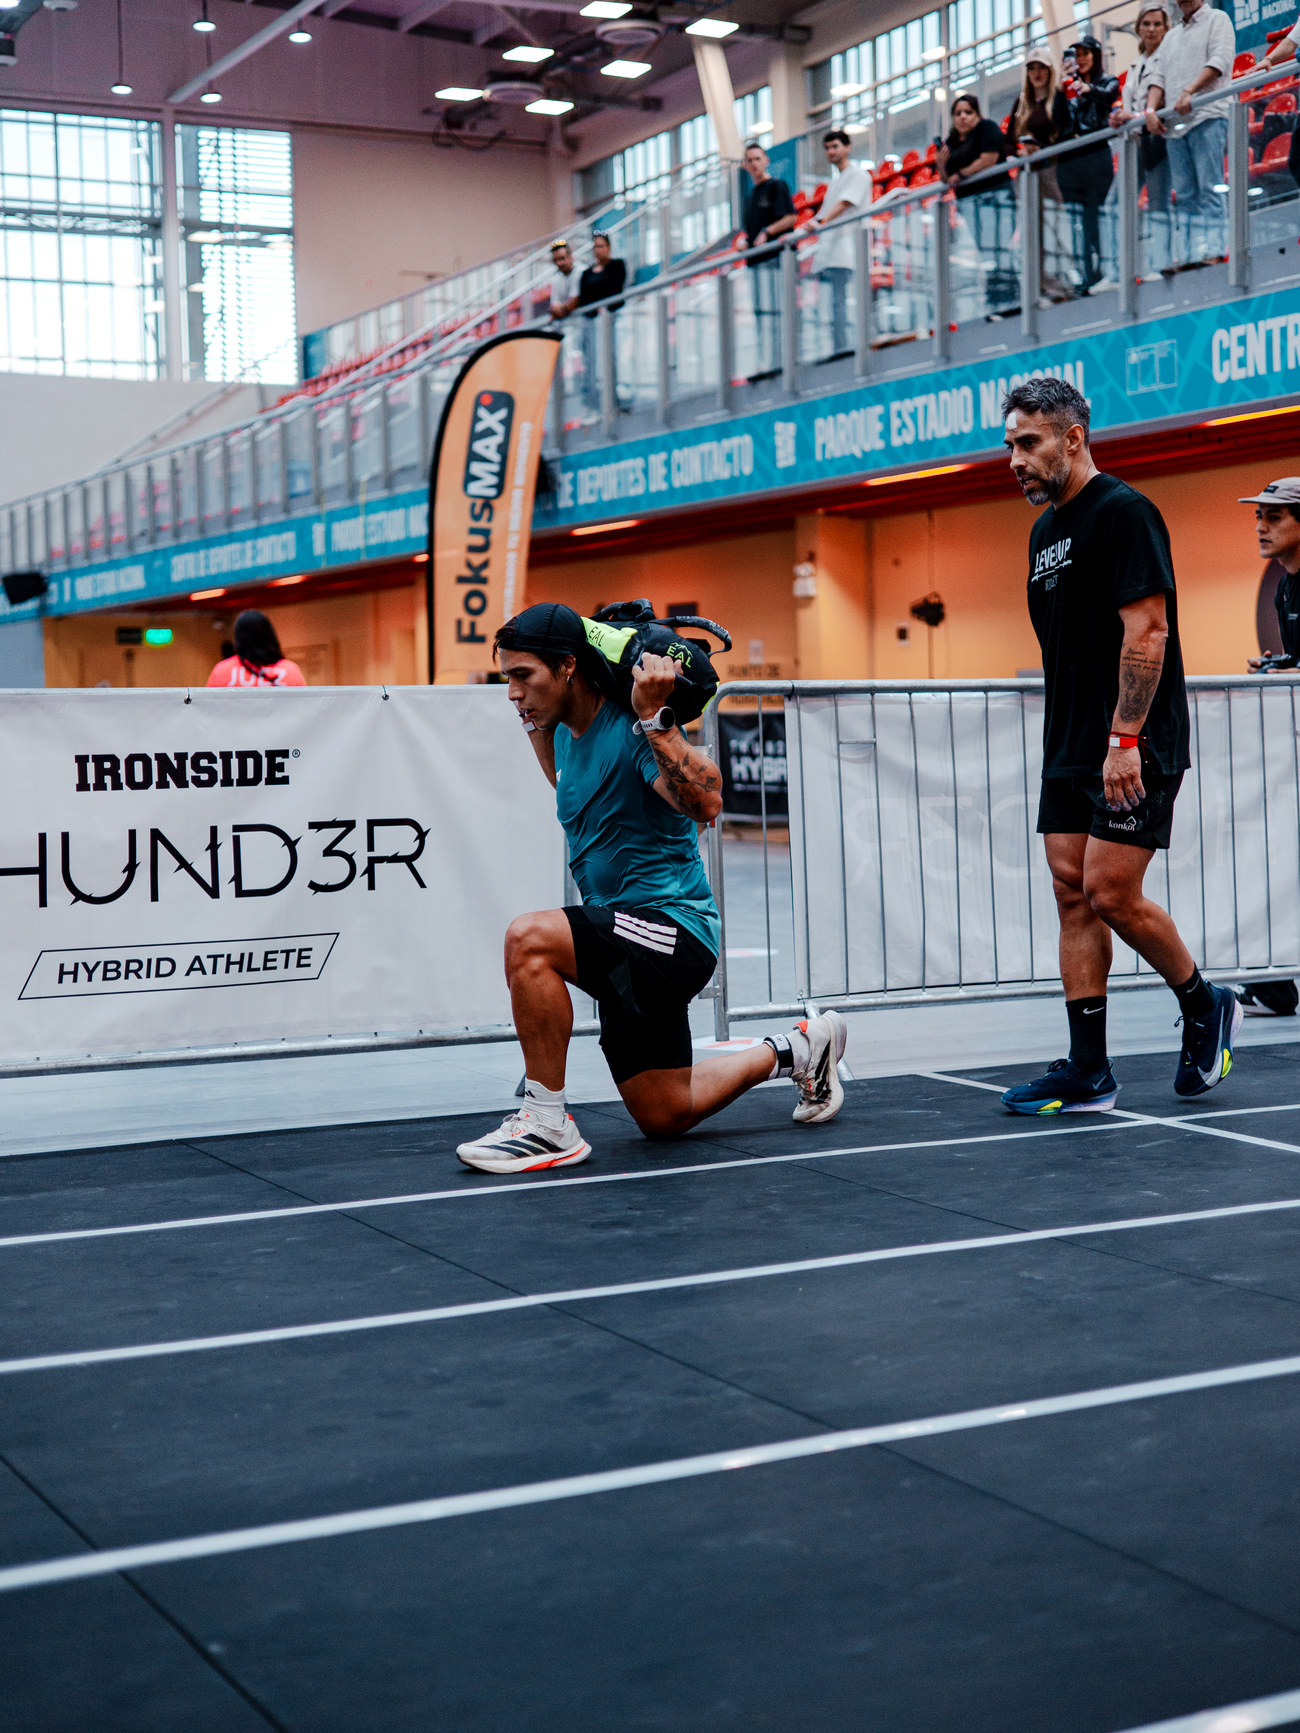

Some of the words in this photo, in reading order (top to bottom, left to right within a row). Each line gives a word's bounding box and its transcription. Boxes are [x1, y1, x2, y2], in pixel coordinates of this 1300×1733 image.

[813, 404, 886, 463] PARQUE
[889, 385, 975, 447] ESTADIO
[576, 456, 646, 506] DEPORTES
[647, 450, 669, 493] DE
[670, 433, 754, 489] CONTACTO
[57, 956, 177, 985] HYBRID
[184, 946, 314, 977] ATHLETE
